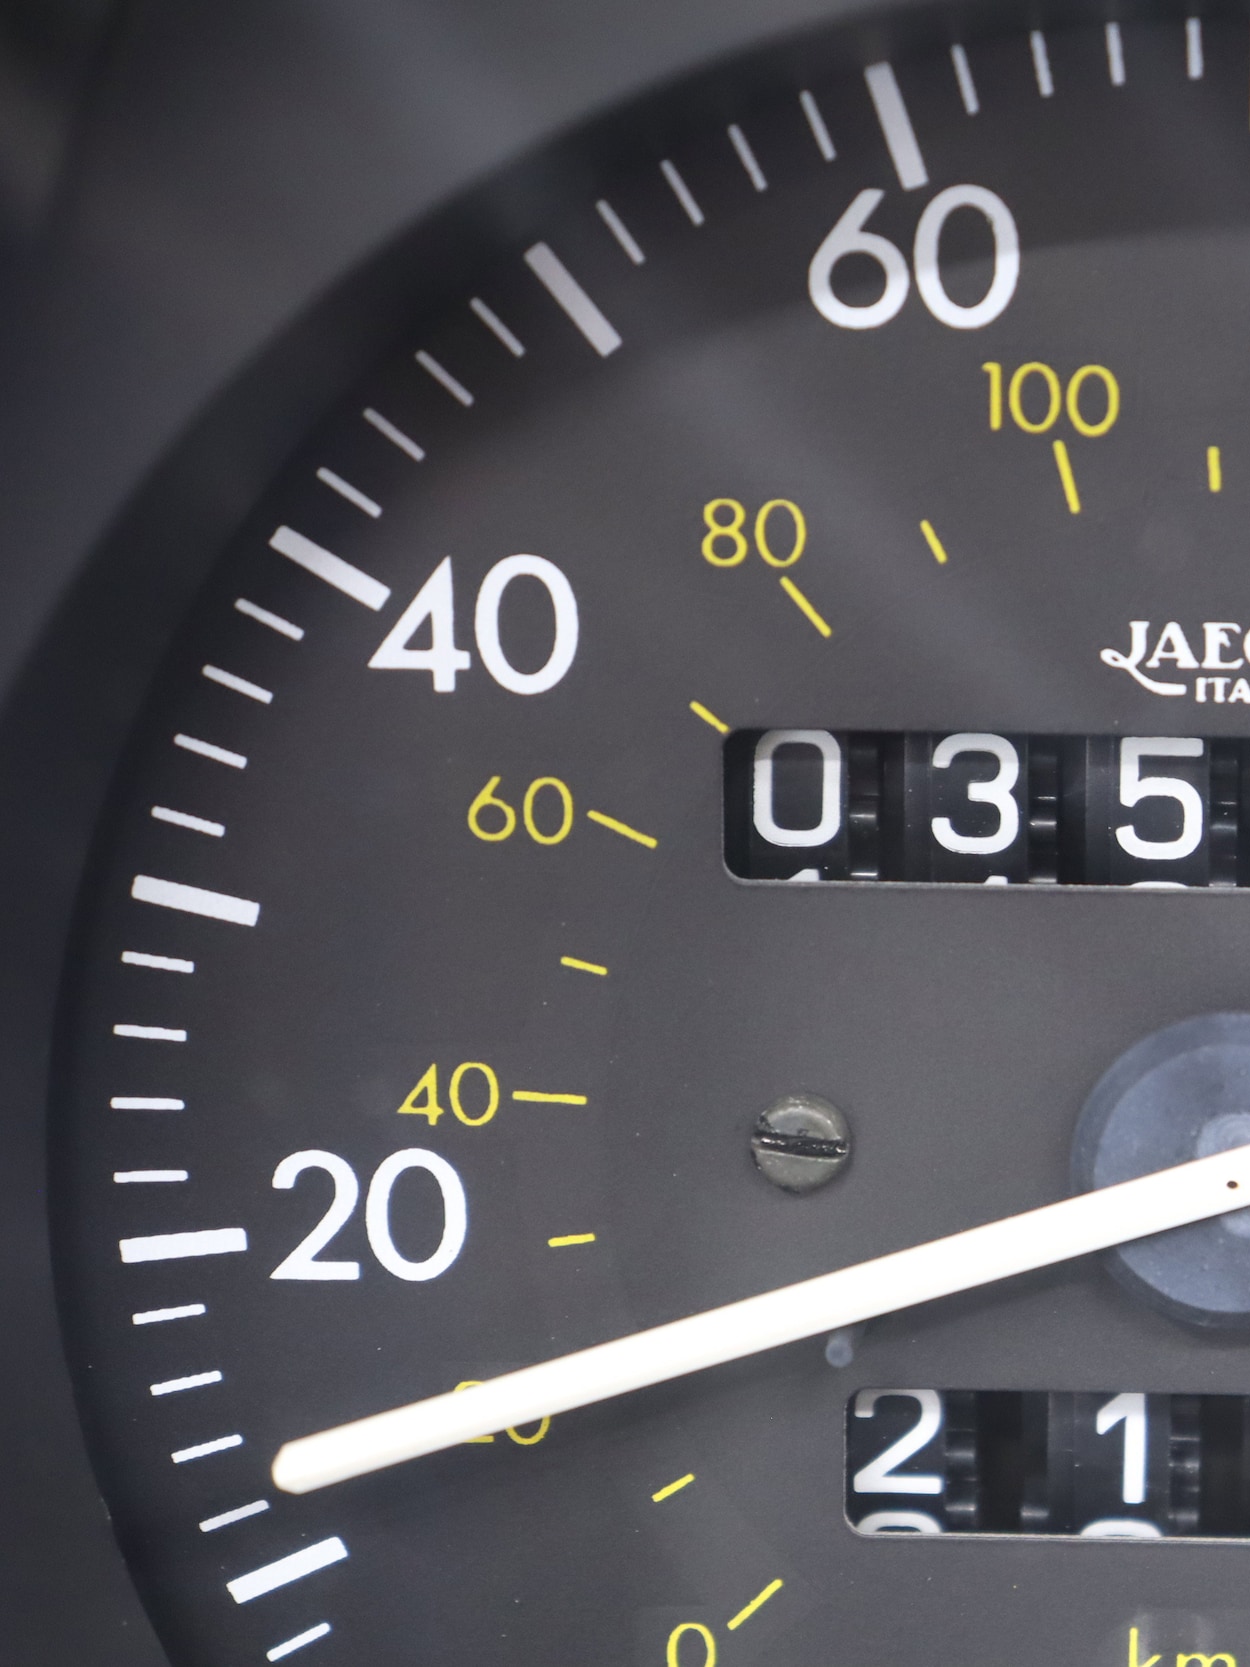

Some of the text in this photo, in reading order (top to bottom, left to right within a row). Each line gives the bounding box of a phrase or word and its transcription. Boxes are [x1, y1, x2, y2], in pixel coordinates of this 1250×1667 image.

[809, 184, 1021, 330] 60
[981, 361, 1121, 437] 100
[700, 498, 808, 569] 80
[367, 553, 580, 696] 40
[467, 775, 575, 846] 60
[397, 1061, 501, 1127] 40
[269, 1147, 469, 1282] 20
